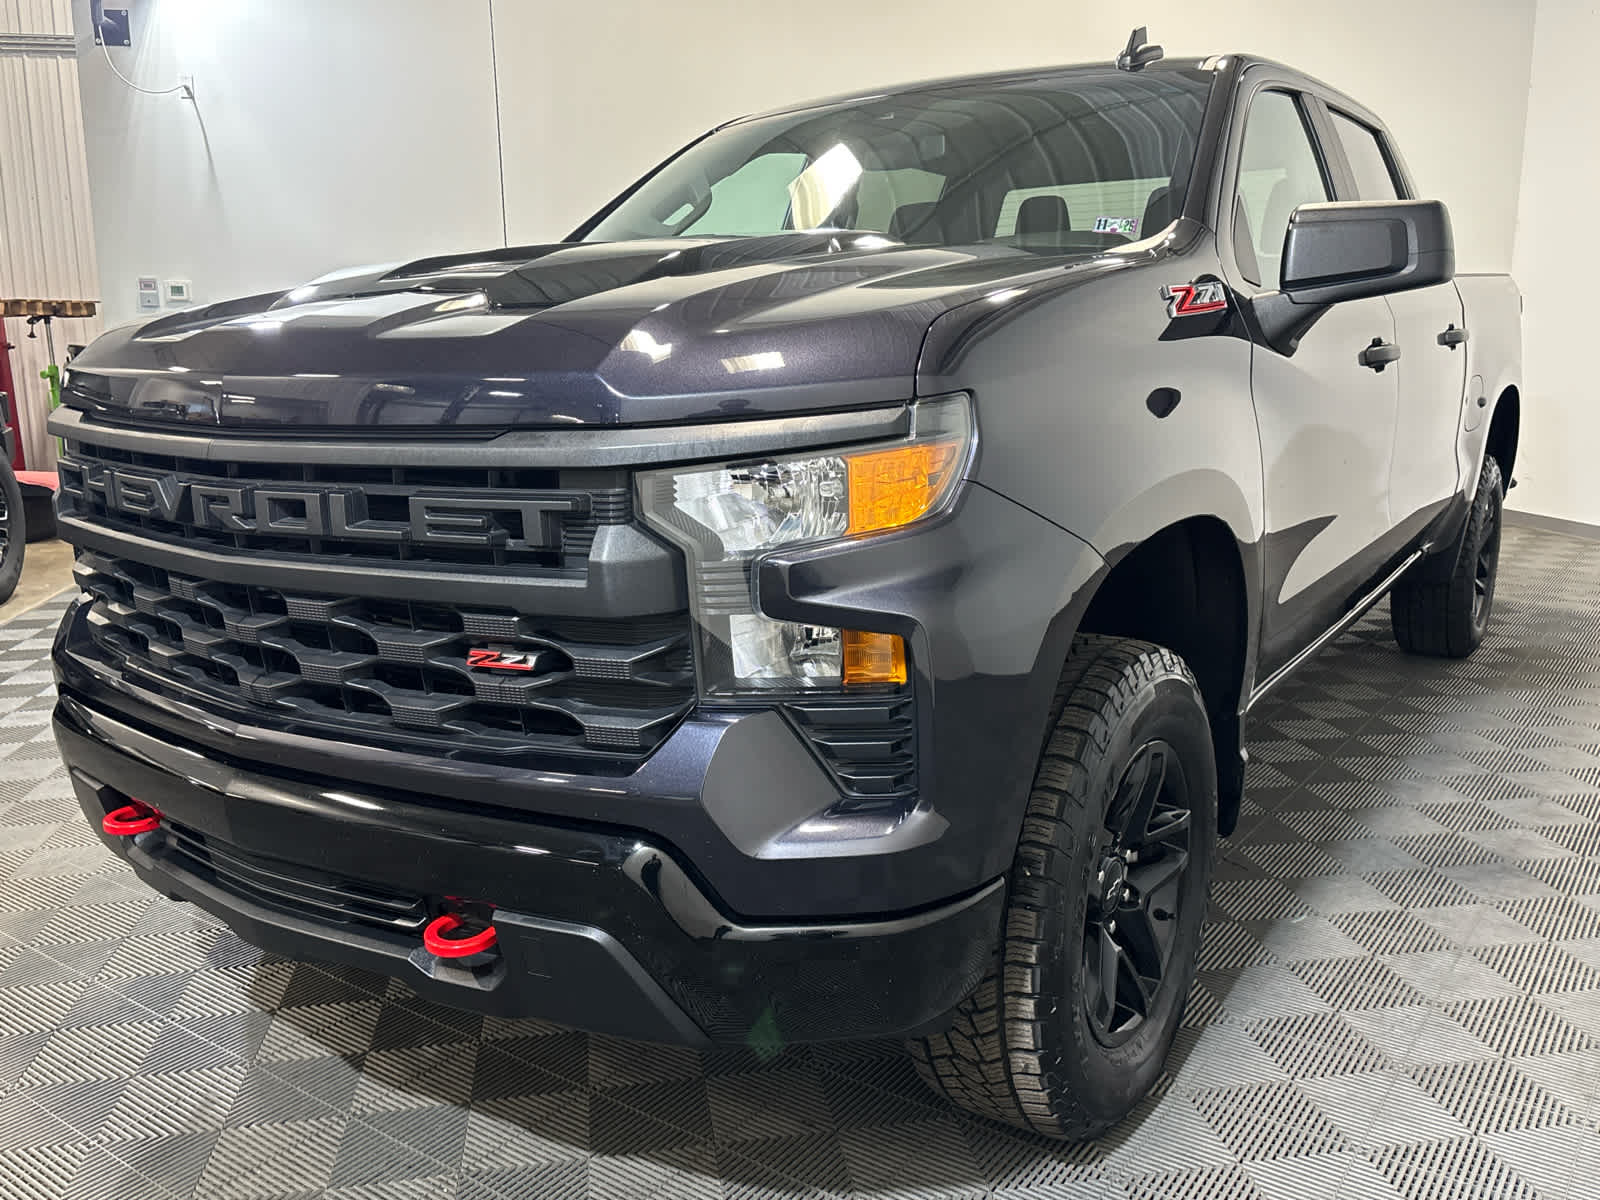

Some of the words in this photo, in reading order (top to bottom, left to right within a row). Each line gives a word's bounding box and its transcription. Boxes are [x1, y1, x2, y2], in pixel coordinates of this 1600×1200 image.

[1096, 218, 1108, 230] 11
[1159, 282, 1228, 318] Z71
[466, 648, 537, 671] Z71
